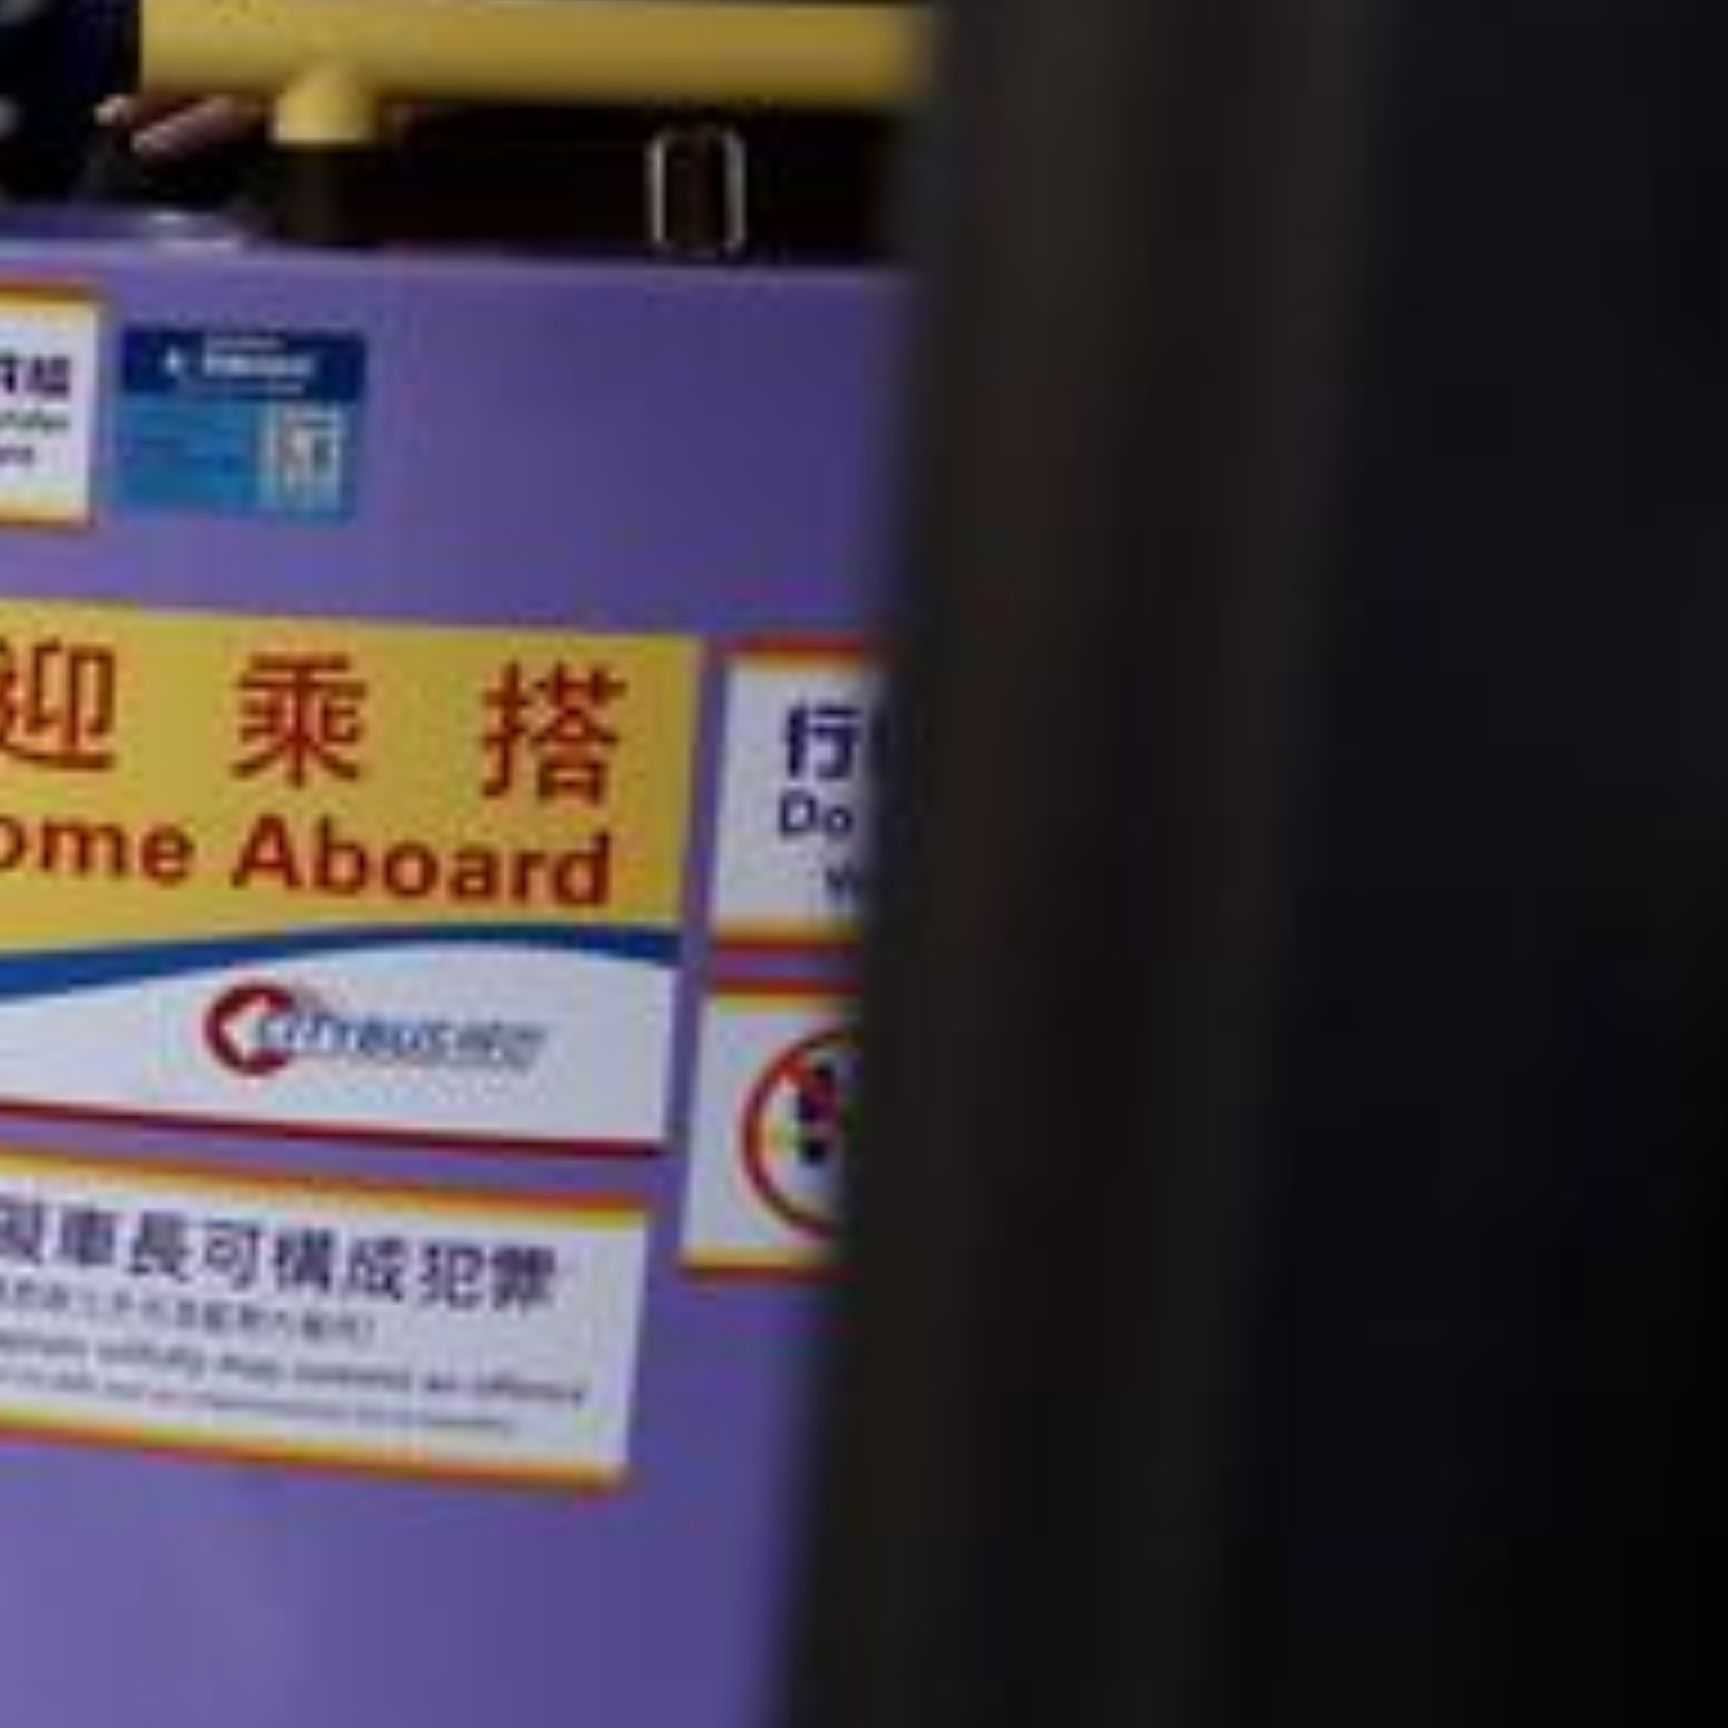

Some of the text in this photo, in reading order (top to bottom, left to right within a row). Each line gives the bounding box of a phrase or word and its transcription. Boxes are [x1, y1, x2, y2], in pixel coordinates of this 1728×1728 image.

[784, 704, 889, 780] 行
[778, 790, 854, 839] Do
[228, 812, 616, 909] Aboard
